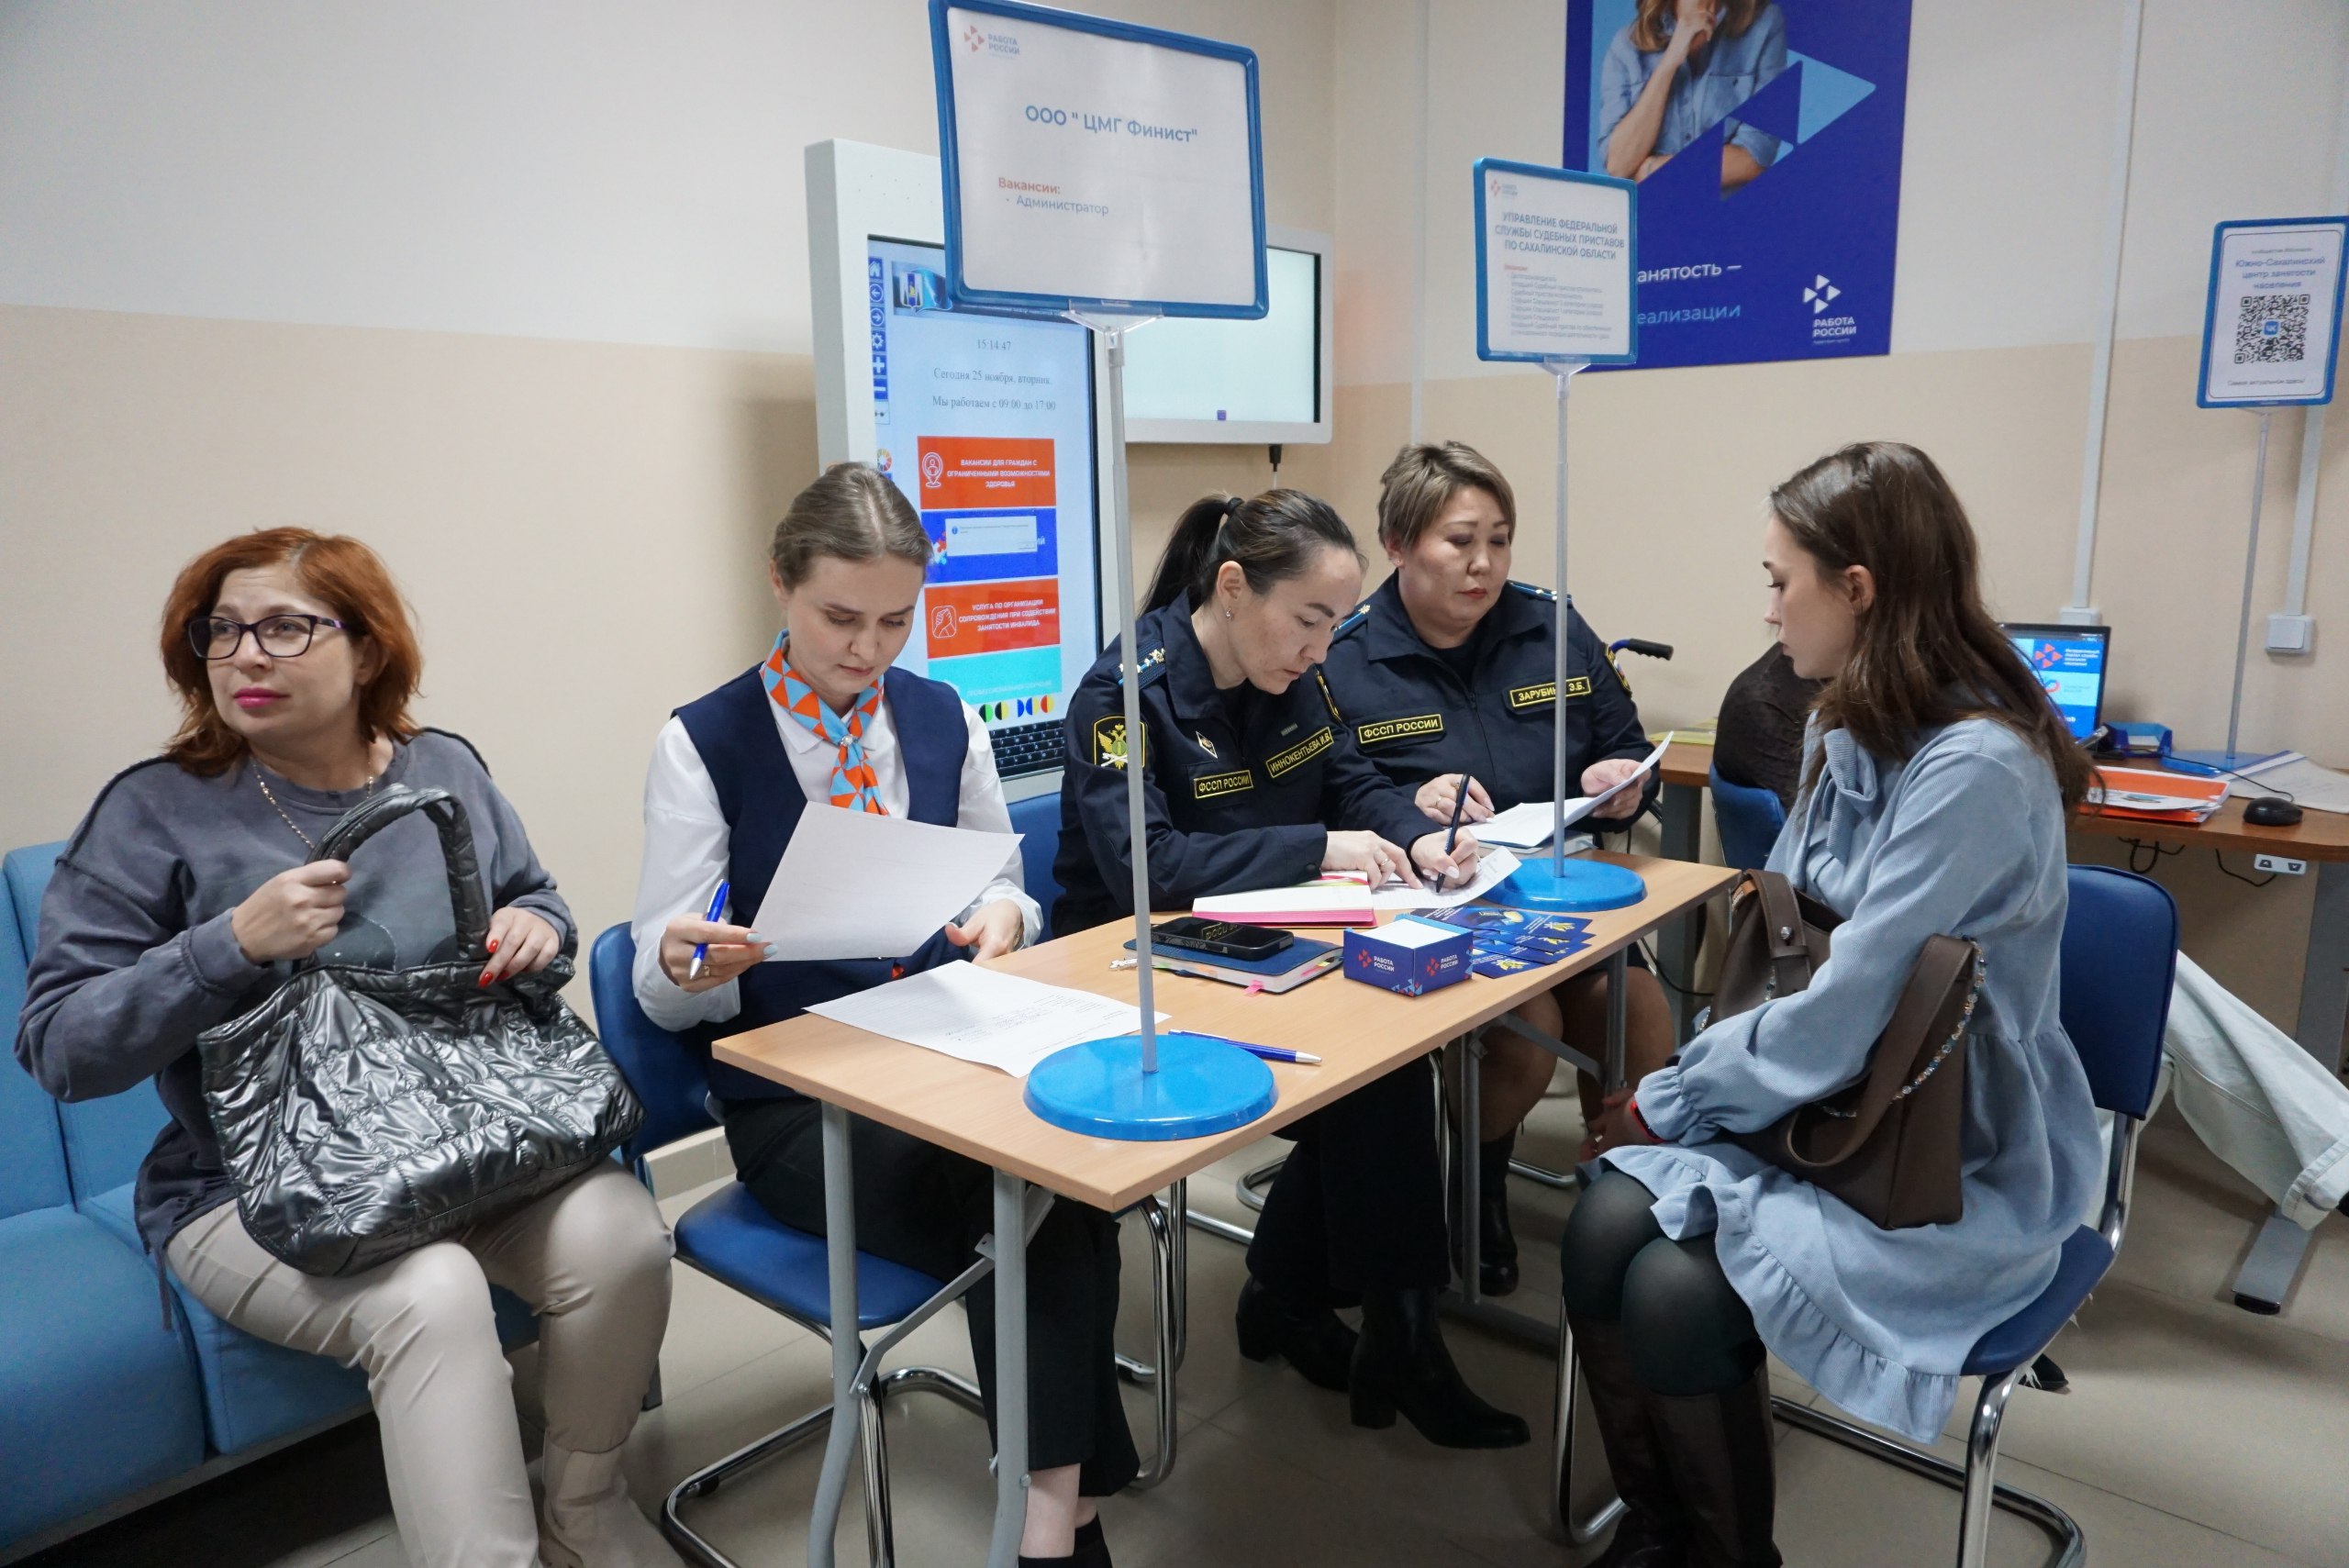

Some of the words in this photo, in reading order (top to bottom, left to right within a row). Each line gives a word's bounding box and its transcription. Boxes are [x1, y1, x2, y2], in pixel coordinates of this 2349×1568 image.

[988, 33, 1018, 46] РАБОТА
[988, 43, 1020, 55] РОССИИ
[1025, 105, 1067, 126] ООО
[1084, 114, 1121, 133] ЦМГ
[1127, 119, 1197, 143] Финист"
[998, 177, 1061, 195] Вакансии:
[1016, 195, 1109, 216] Администратор
[1502, 212, 1557, 228] УПРАВЛЕНИЕ
[1559, 218, 1618, 235] ФЕДЕРАЛЬНОЙ
[1495, 225, 1532, 239] СЛУЖБЫ
[1534, 229, 1576, 244] СУДЕБНЫХ
[1578, 235, 1625, 249] ПРИСТАВОВ
[1505, 239, 1518, 250] ПО
[1519, 241, 1578, 257] САХАЛИНСКОЙ
[1580, 249, 1616, 261] ОБЛАСТИ
[1637, 263, 1722, 283] анятость
[1637, 305, 1741, 324] еализации
[1813, 317, 1855, 328] РАБОТА
[1812, 326, 1857, 338] РОССИИ
[933, 368, 970, 381] Сегодня
[972, 370, 982, 381] 25
[932, 395, 949, 406] Мы
[951, 396, 990, 409] работаем
[1569, 681, 1586, 692] Э.Б.
[1364, 725, 1394, 739] ФССП
[1396, 718, 1439, 733] РОССИИ
[1270, 740, 1320, 772] ИННОКЕНТЬЕВА
[1198, 779, 1223, 793] ФССП
[1223, 775, 1250, 789] РОССИИ
[1374, 955, 1394, 966] РАБОТА
[1441, 954, 1458, 963] РАБОТА
[1441, 960, 1458, 970] РОССИИ
[1374, 962, 1395, 973] РОССИИ
